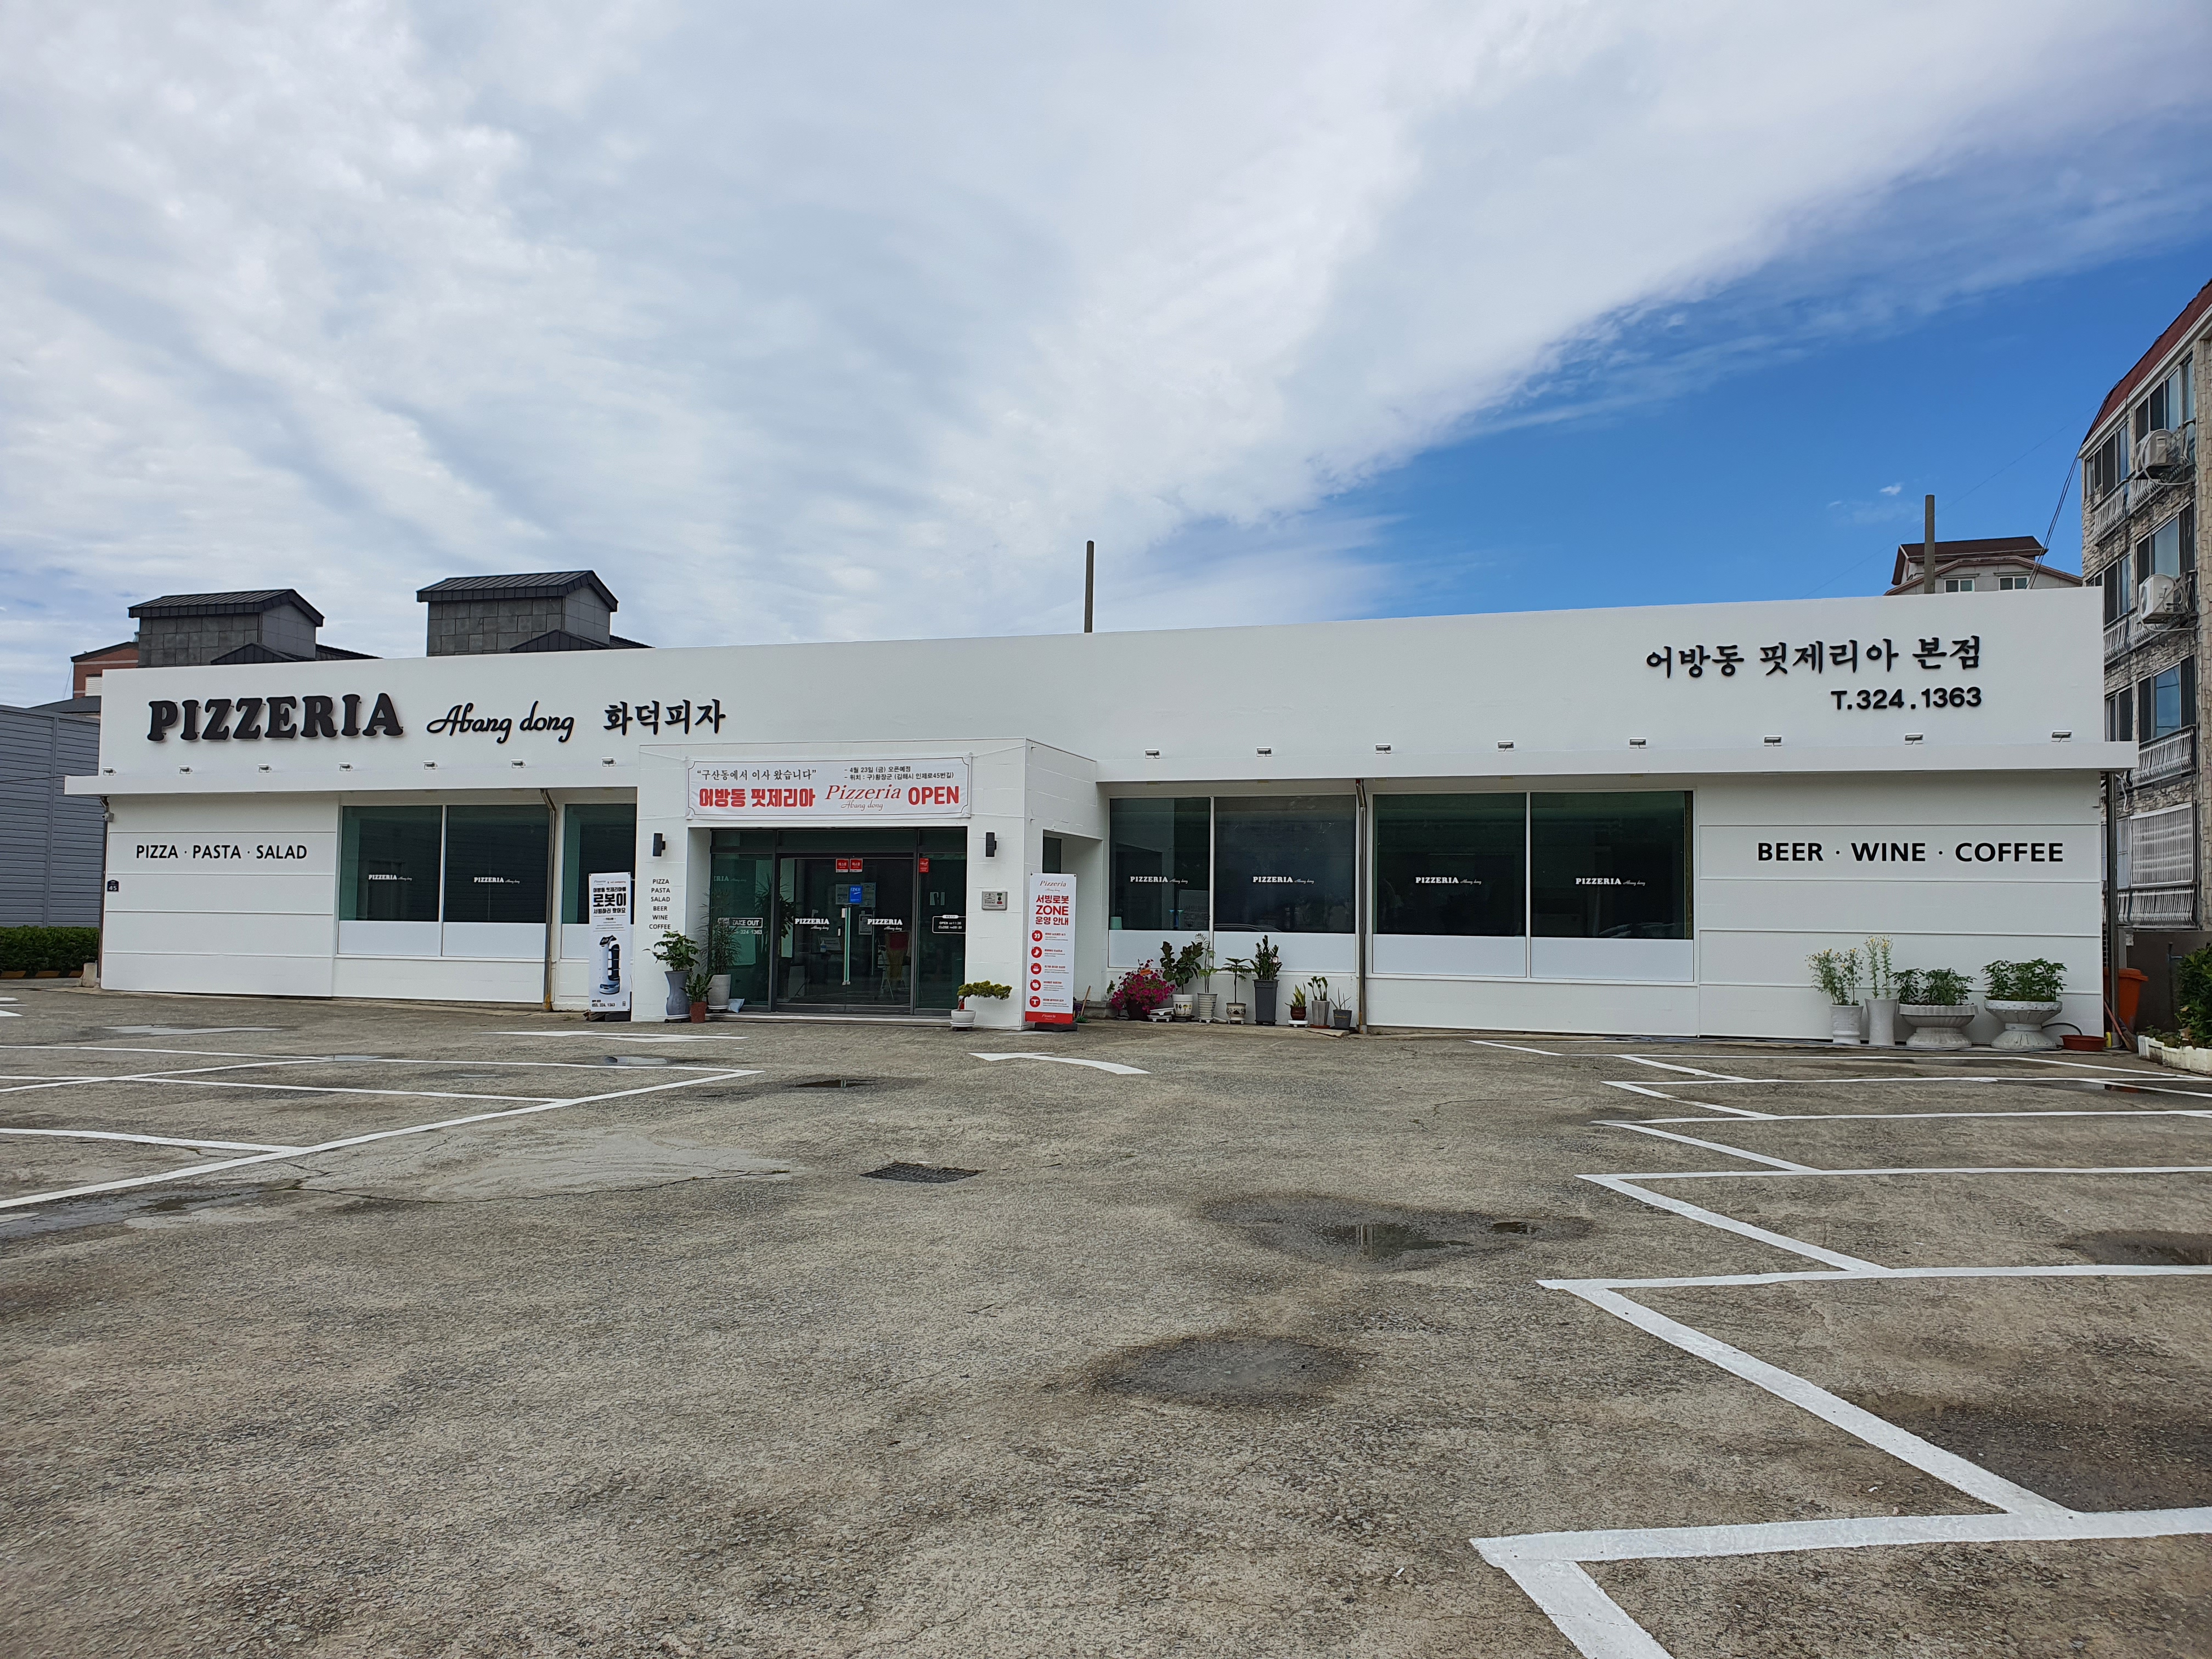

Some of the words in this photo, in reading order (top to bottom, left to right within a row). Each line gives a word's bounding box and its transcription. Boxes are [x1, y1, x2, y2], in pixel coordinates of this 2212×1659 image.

[1646, 645, 1744, 679] 어방동
[1760, 639, 1899, 676] 핏제리아
[1912, 635, 1979, 670] 본점
[147, 693, 404, 743] PIZZERIA
[427, 703, 512, 744] Abang
[520, 701, 574, 743] dong
[603, 699, 726, 736] 화덕피자
[752, 770, 770, 780] 이사
[699, 788, 746, 807] 어방동
[751, 788, 815, 807] 핏제리아
[825, 785, 901, 801] Pizzeria
[909, 786, 959, 805] OPEN
[868, 800, 883, 811] dong
[137, 845, 178, 858] PIZZA
[193, 845, 241, 859] PASTA
[257, 845, 307, 859] SALAD
[1758, 843, 1823, 861] BEER
[1851, 843, 1925, 861] WINE
[1956, 843, 2063, 862] COFFEE
[593, 893, 626, 907] 로봇이
[1036, 895, 1069, 904] 서빙로봇
[1036, 905, 1069, 916] ZONE
[1053, 917, 1068, 926] 안내
